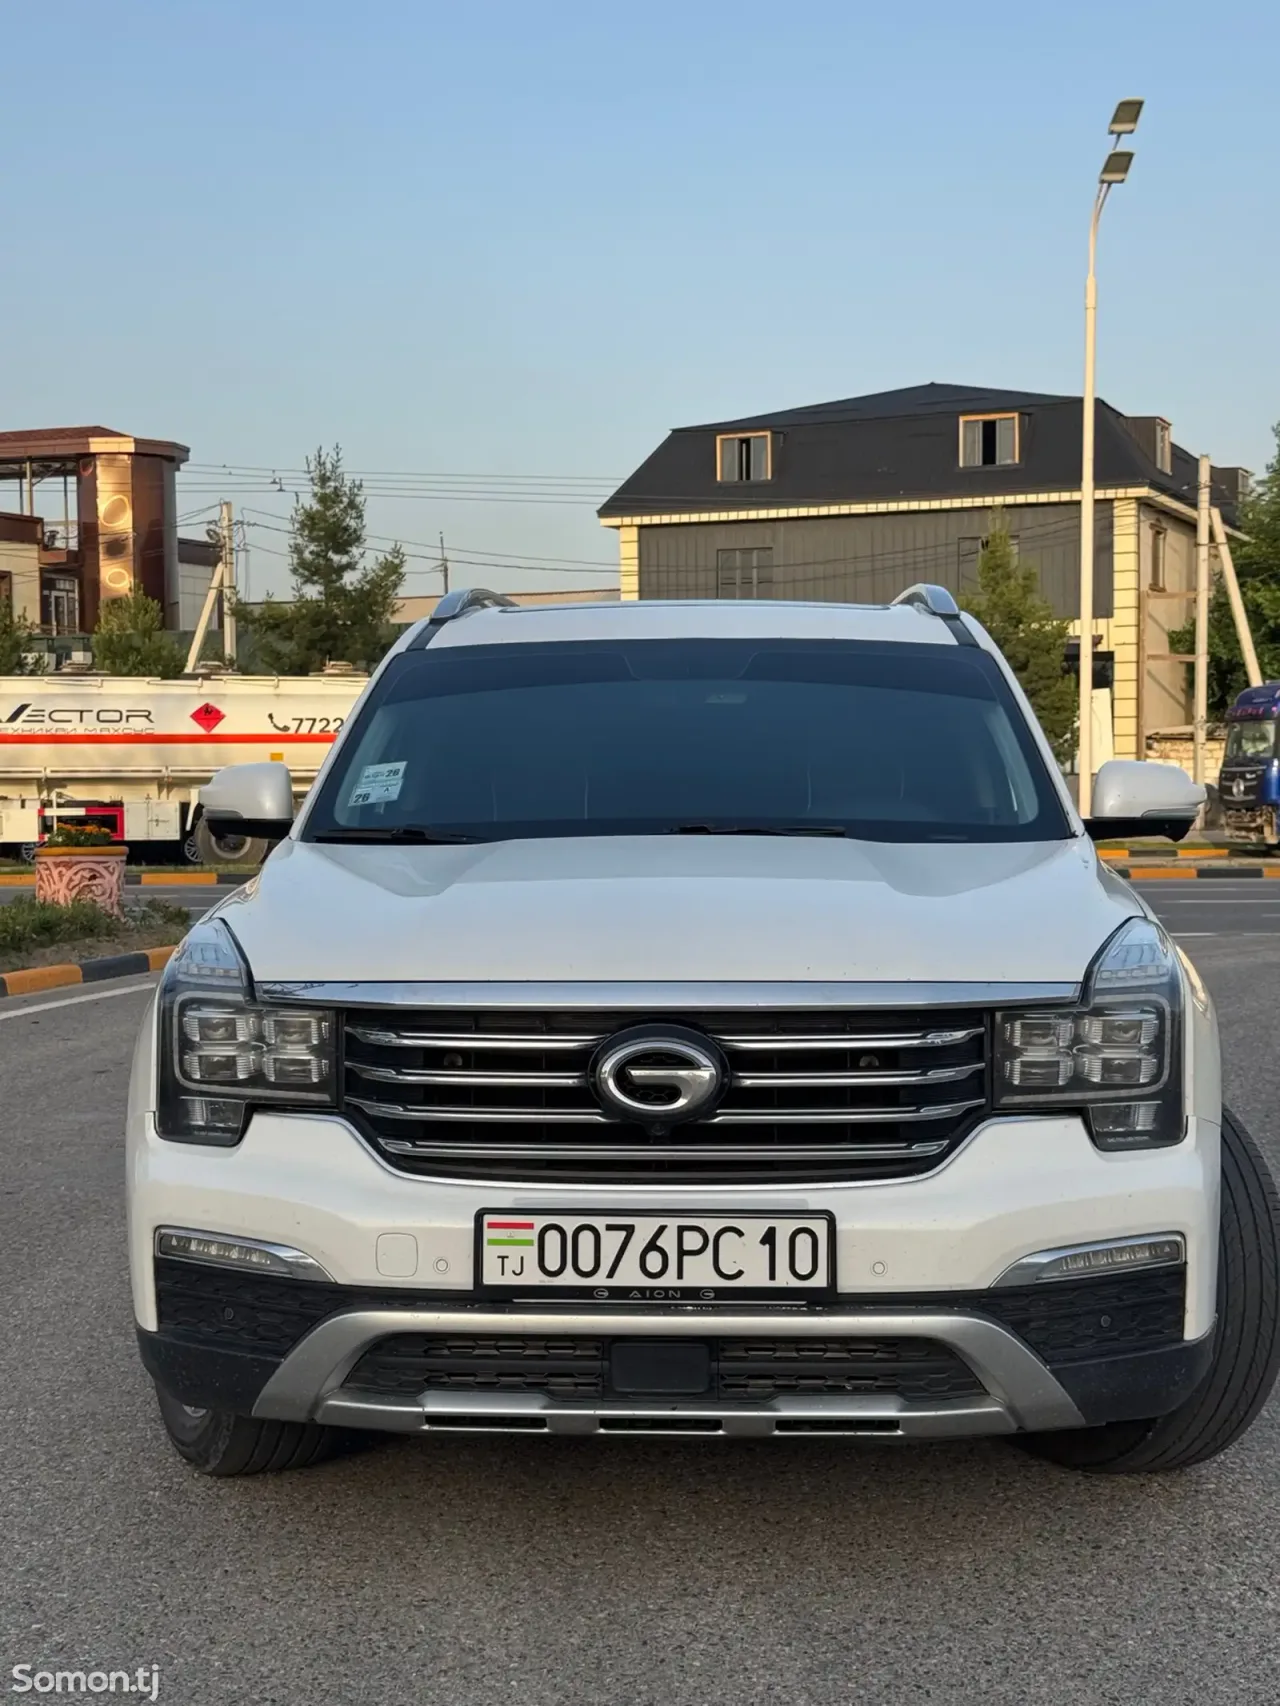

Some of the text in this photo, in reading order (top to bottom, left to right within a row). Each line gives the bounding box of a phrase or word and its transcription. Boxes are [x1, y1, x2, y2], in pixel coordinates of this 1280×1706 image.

[291, 717, 344, 734] 7722
[537, 1222, 819, 1281] 0076PC 10
[497, 1256, 524, 1277] TJ
[629, 1290, 681, 1298] AION
